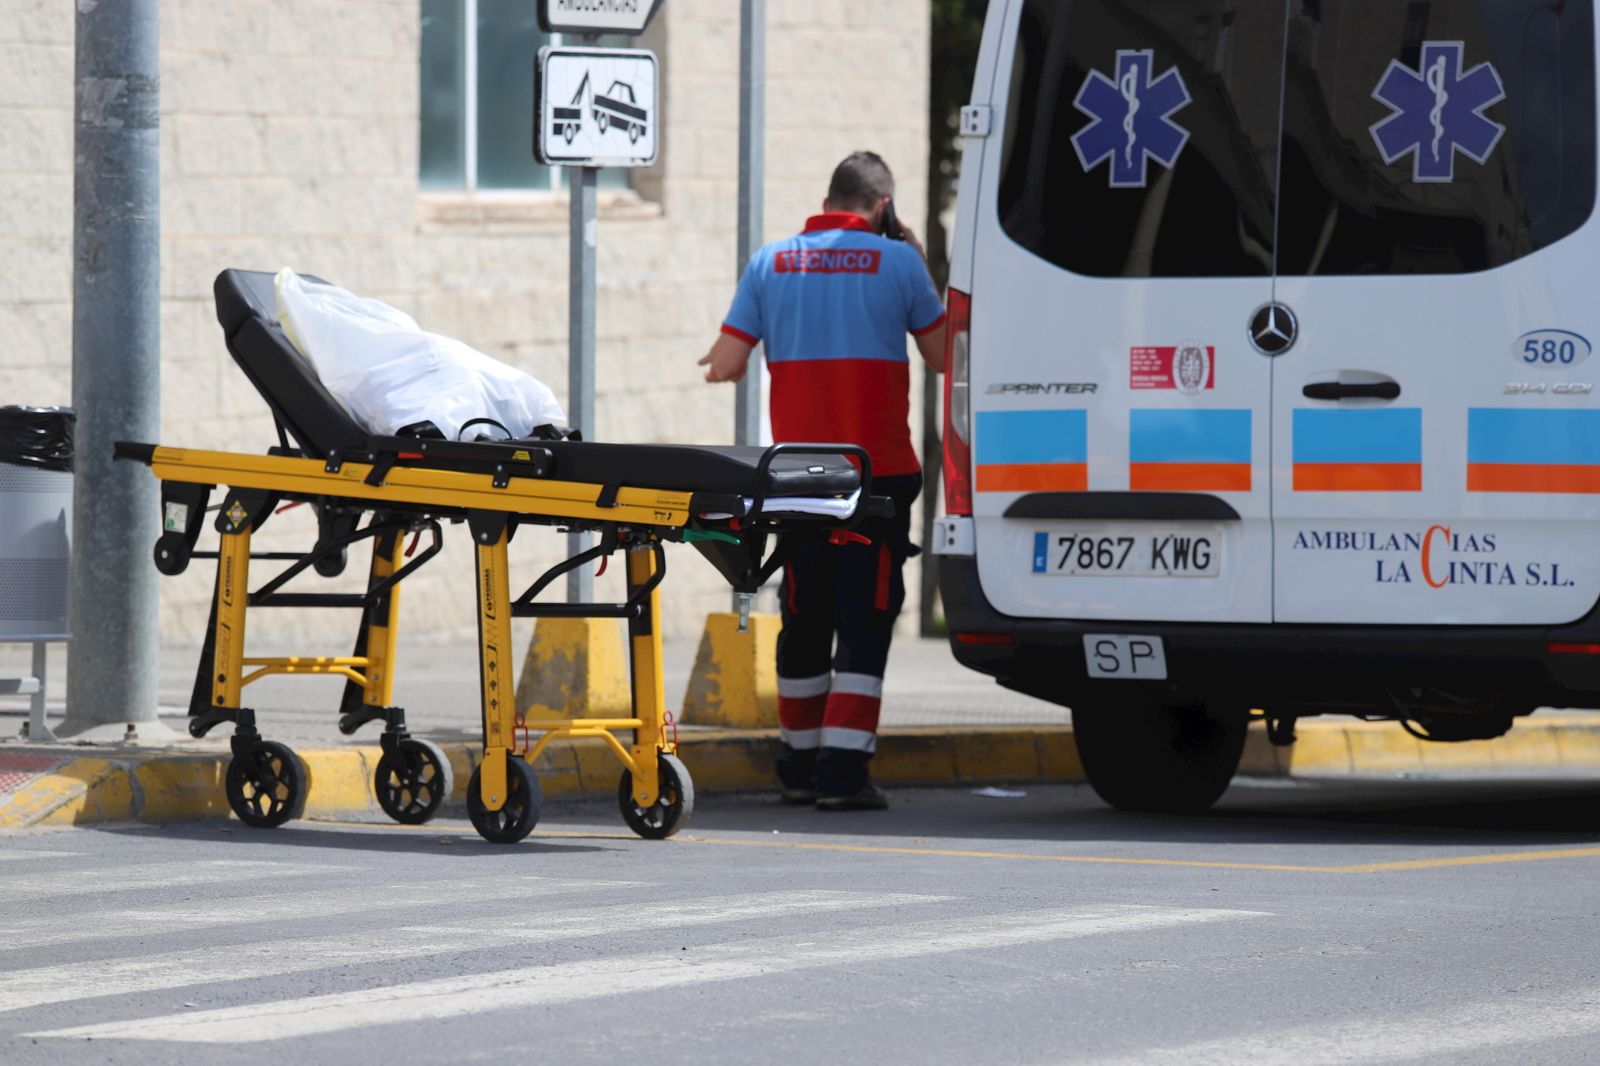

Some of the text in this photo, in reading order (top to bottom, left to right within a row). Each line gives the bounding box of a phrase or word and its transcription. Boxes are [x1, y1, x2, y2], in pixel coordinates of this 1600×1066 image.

[1523, 339, 1575, 364] 580
[984, 382, 1099, 395] SPRINTER
[1057, 537, 1135, 570] 7867
[1151, 537, 1212, 570] KWG
[1374, 560, 1412, 583] LA
[1524, 562, 1575, 587] S.L.
